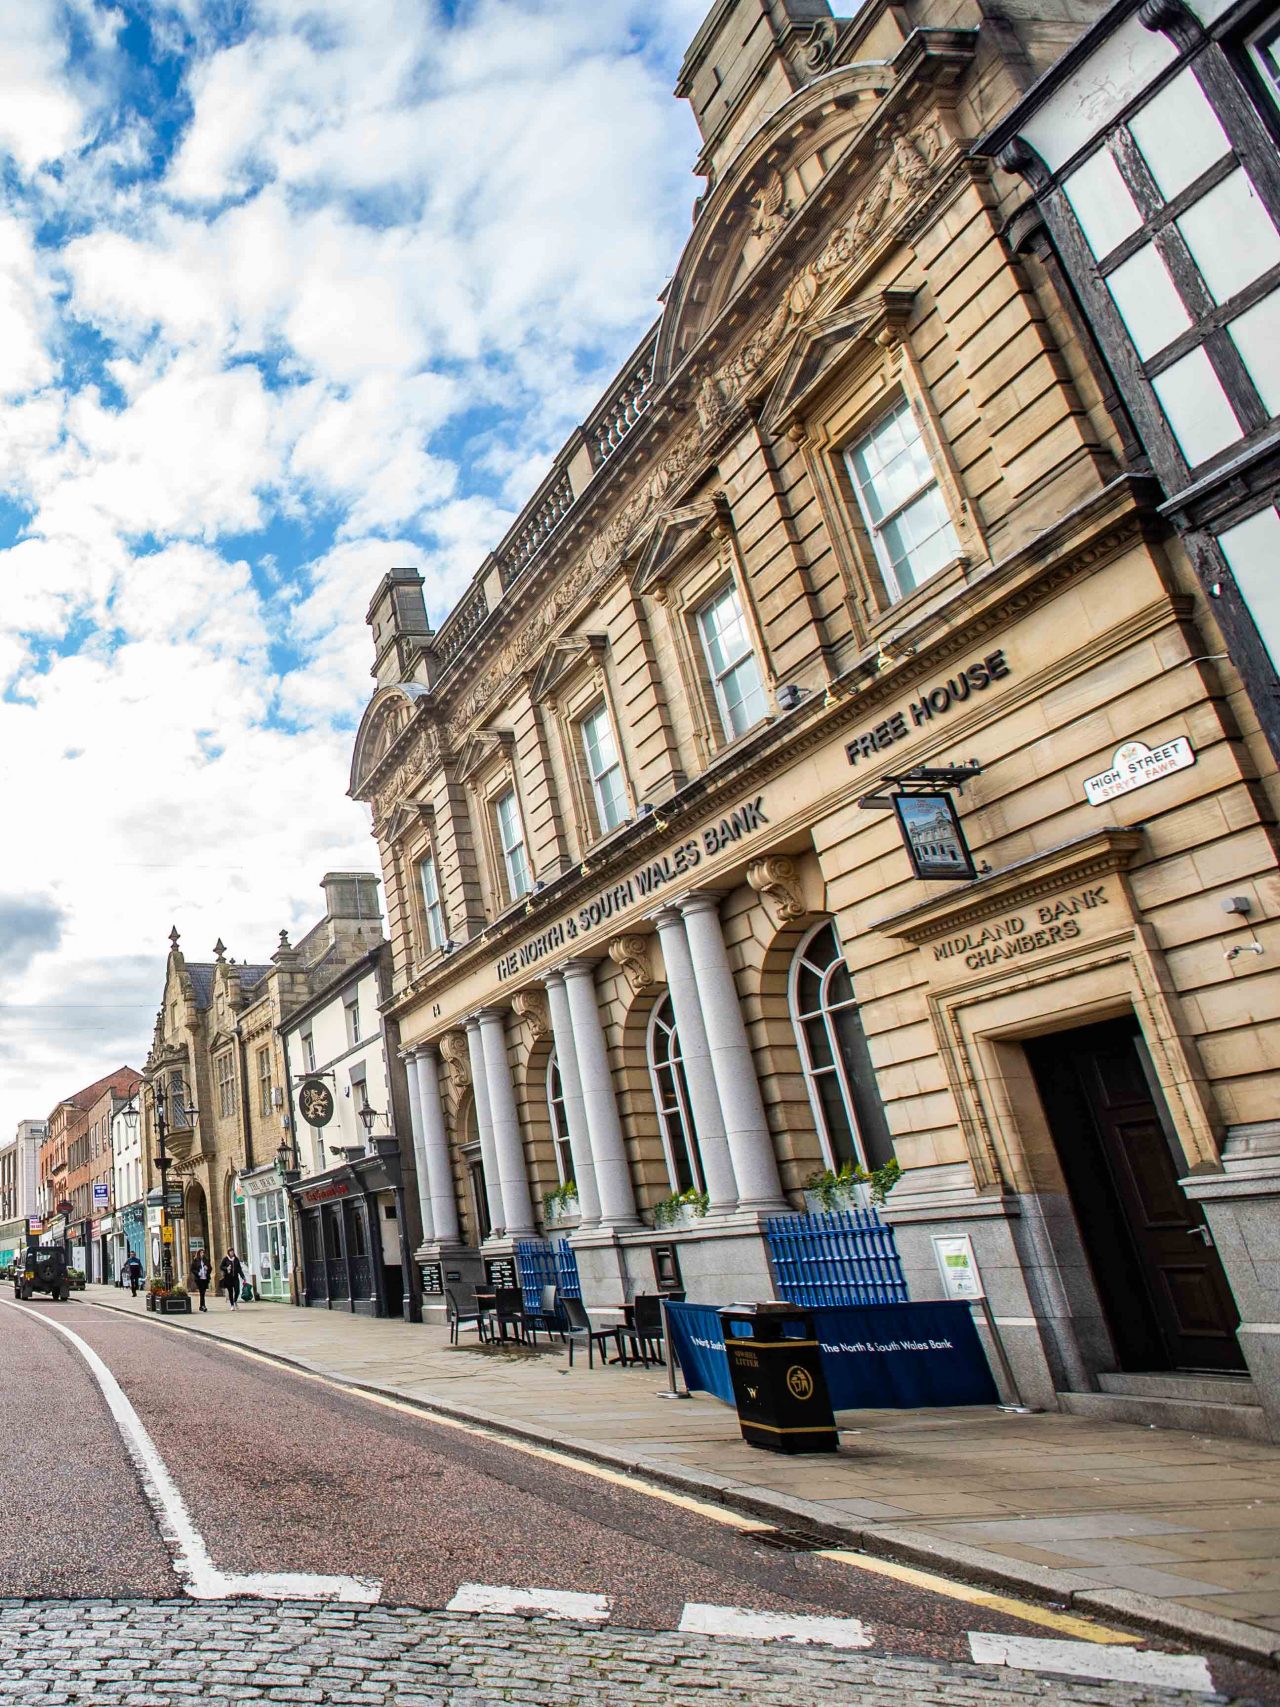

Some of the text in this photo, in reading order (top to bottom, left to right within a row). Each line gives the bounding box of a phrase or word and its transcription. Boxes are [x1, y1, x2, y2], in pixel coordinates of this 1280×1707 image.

[844, 649, 1010, 766] FREE HOUSE
[1091, 743, 1180, 790] HIGH STREET
[1102, 759, 1177, 796] STRYT FAWR
[493, 796, 769, 981] THE NORTH & SOUTH WALES BANK
[932, 886, 1109, 961] MIDLAND BANK
[965, 919, 1081, 969] CHAMBERS
[821, 1338, 954, 1353] The North & South Wales Bank
